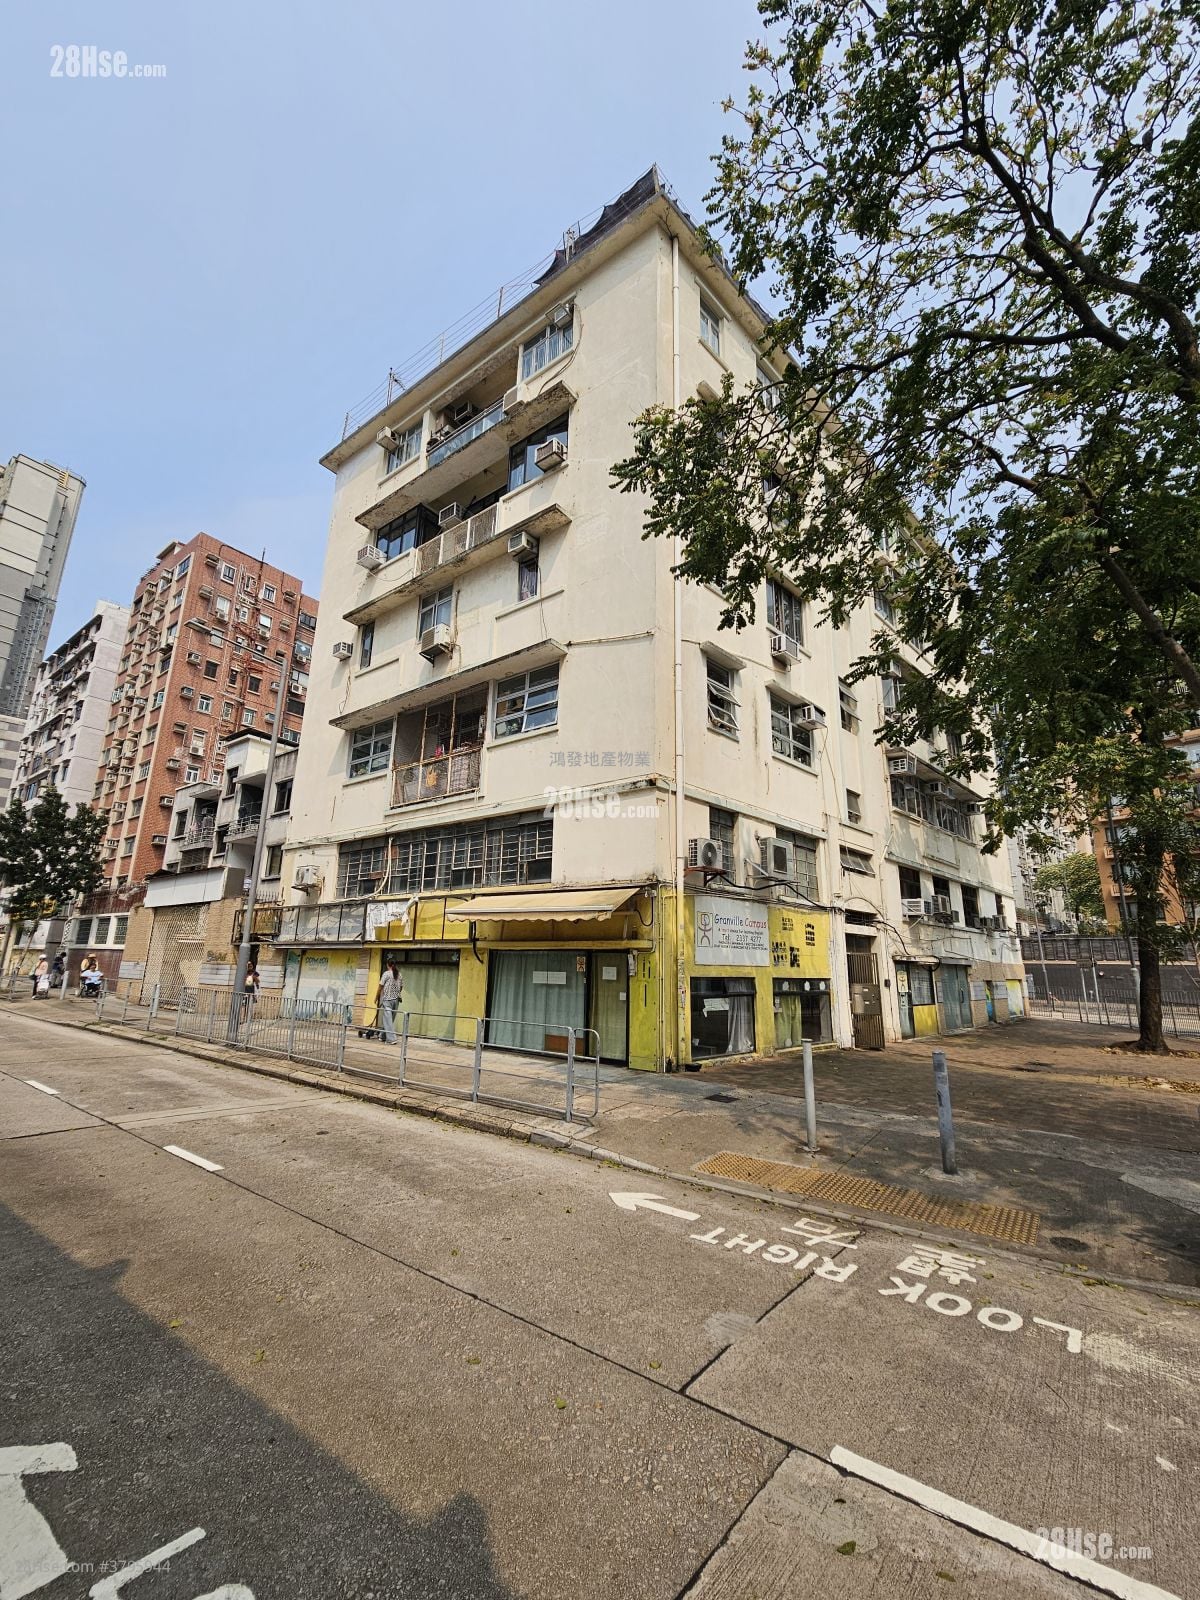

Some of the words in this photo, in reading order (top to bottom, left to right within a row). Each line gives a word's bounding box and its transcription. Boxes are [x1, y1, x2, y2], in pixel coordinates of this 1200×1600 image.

[714, 913, 744, 927] Granville
[744, 917, 767, 929] Campus
[690, 1227, 859, 1283] RIGHT
[780, 1217, 862, 1250] 右
[878, 1275, 1083, 1354] LOOK
